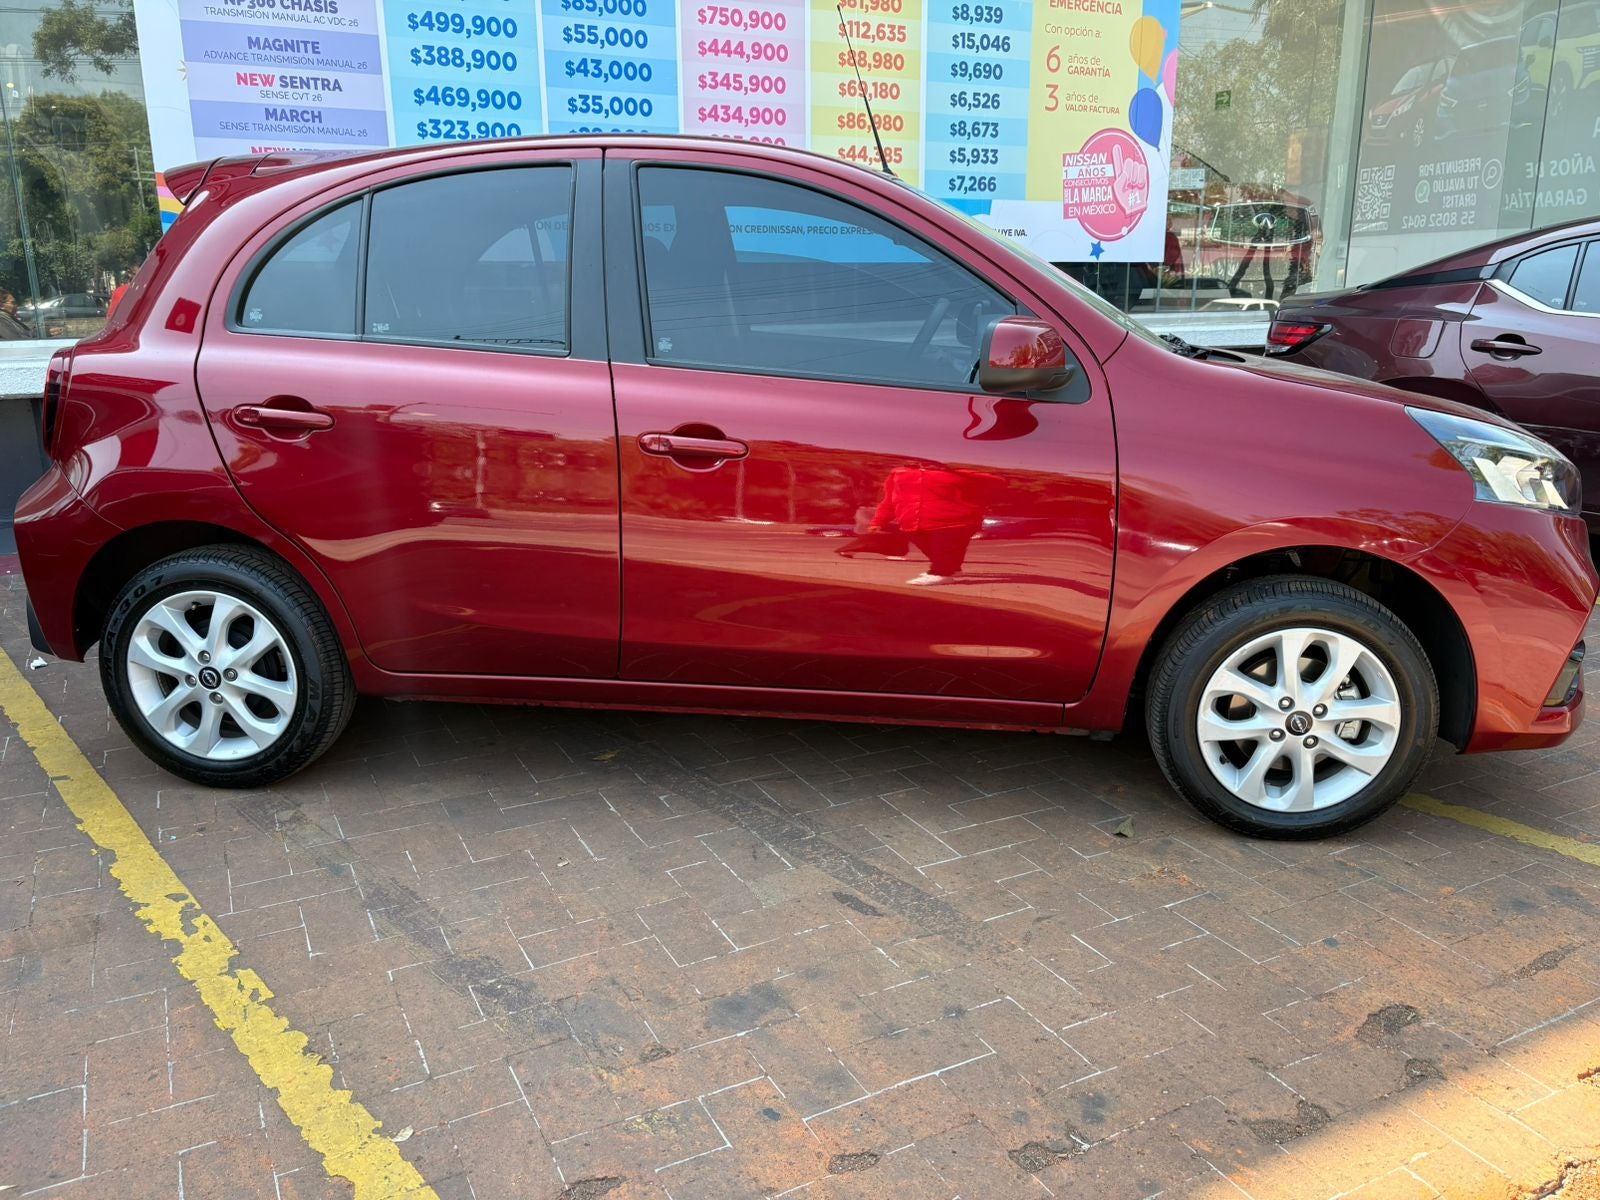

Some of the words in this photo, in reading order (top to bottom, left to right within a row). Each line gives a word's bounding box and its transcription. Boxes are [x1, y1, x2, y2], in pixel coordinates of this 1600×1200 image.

[204, 6, 270, 20] TRANSMISIÓN
[272, 13, 312, 24] MANUAL
[313, 15, 327, 25] AC
[327, 17, 347, 26] VDC
[348, 19, 359, 27] 26
[952, 3, 1003, 25] $8,939
[1049, 0, 1123, 15] EMERGENCIA
[407, 10, 518, 39] $499,900
[697, 6, 787, 32] $750,900
[562, 24, 648, 49] $55,000
[838, 20, 907, 43] $112,635
[1044, 23, 1063, 34] Con
[1064, 26, 1093, 38] opción
[247, 36, 321, 54] MAGNITE
[697, 39, 789, 63] $444,900
[951, 32, 1011, 54] $15,046
[203, 50, 249, 62] ADVANCE
[250, 53, 314, 66] TRANSMISIÓN
[316, 58, 355, 69] MANUAL
[357, 61, 367, 70] 26
[410, 45, 518, 72] $388,900
[838, 50, 905, 71] $88,980
[1046, 45, 1061, 73] 6
[1067, 54, 1088, 65] años
[1090, 56, 1101, 66] de
[565, 58, 652, 83] $43,000
[950, 61, 1003, 81] $9,690
[1067, 65, 1111, 78] GARANTÍA
[236, 72, 275, 87] NEW
[279, 75, 343, 92] SENTRA
[698, 71, 786, 95] $345,900
[838, 80, 901, 101] $69,180
[259, 90, 289, 100] SENSE
[291, 92, 311, 101] CVT
[312, 93, 323, 102] 26
[413, 86, 522, 112] $469,900
[950, 91, 1001, 111] $6,526
[1045, 84, 1059, 112] 3
[1065, 91, 1086, 103] años
[1088, 93, 1099, 104] de
[264, 107, 323, 124] MARCH
[567, 94, 653, 119] $35,000
[698, 104, 787, 128] $434,900
[1065, 104, 1088, 113] VALOR
[1089, 105, 1121, 115] FACTURA
[219, 121, 251, 131] SENSE
[252, 122, 316, 135] TRANSMISIÓN
[317, 127, 355, 137] MANUAL
[357, 129, 368, 138] 26
[416, 118, 522, 140] $323,900
[837, 112, 904, 133] $86,980
[949, 120, 999, 140] $8,673
[949, 148, 998, 166] $5,933
[1064, 152, 1107, 166] NISSAN
[1078, 166, 1106, 178] AÑOS
[948, 175, 997, 194] $7,266
[1068, 188, 1080, 204] LA
[1081, 186, 1113, 203] MARCA
[1068, 206, 1081, 217] EN
[1082, 202, 1117, 215] MÉXICO
[744, 225, 806, 235] CREDINISSAN,
[807, 225, 839, 235] PRECIO
